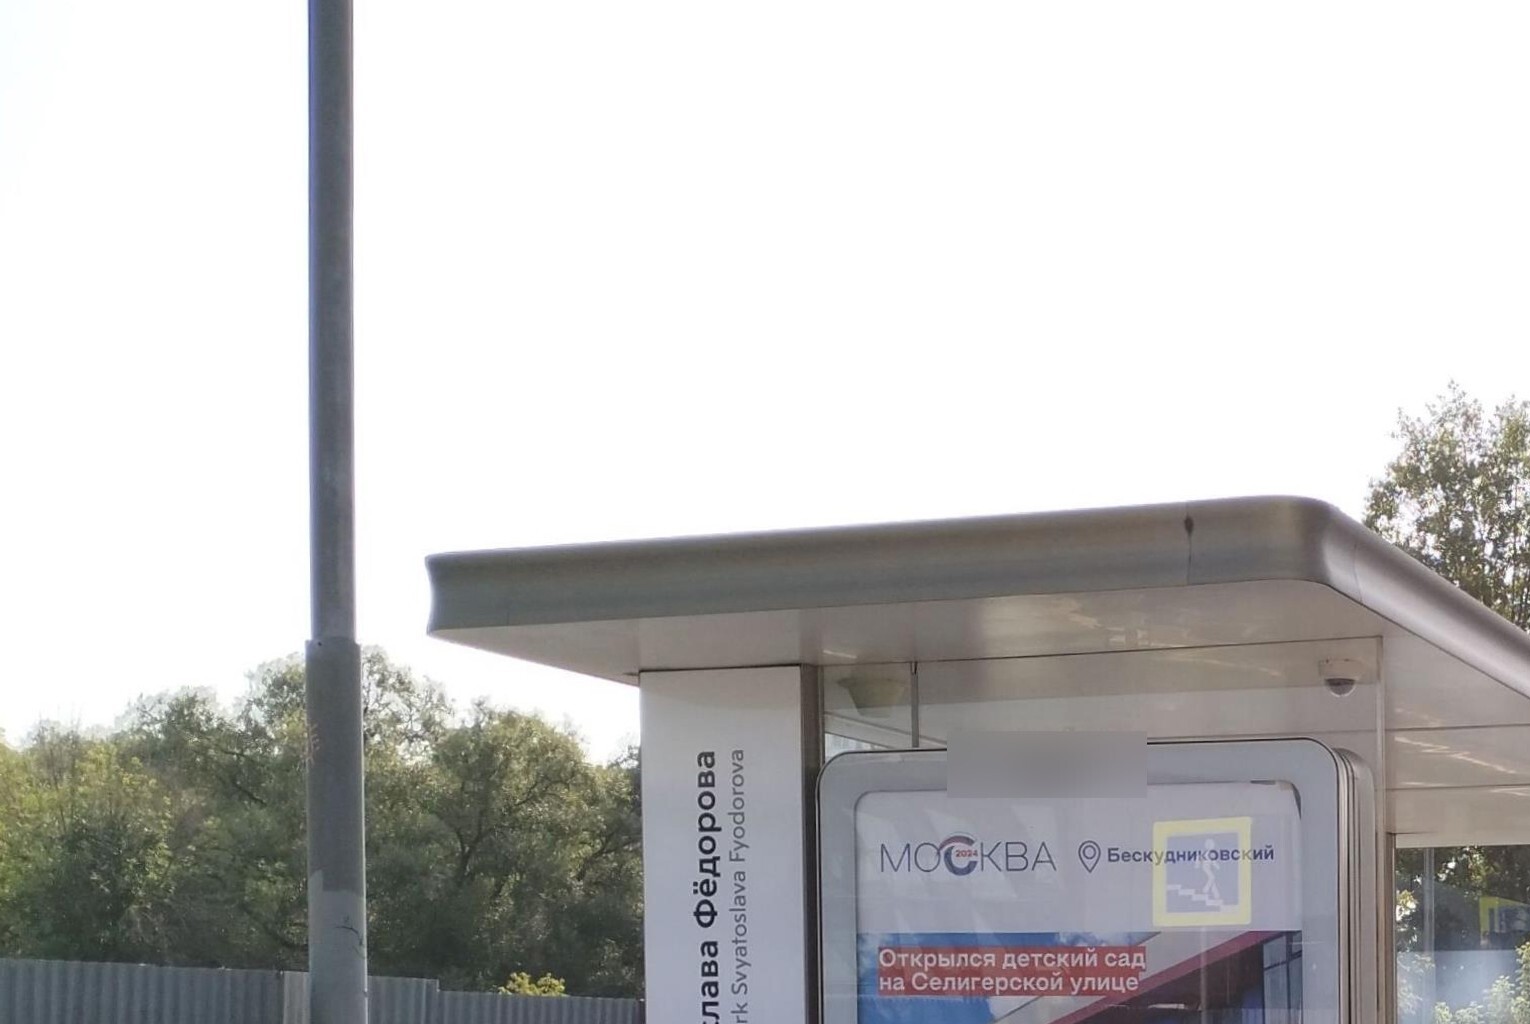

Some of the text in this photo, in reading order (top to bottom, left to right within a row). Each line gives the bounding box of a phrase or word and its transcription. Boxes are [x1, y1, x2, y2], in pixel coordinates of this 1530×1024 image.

[728, 750, 750, 861] Fyodorova
[693, 751, 722, 928] Фёдорова
[880, 832, 1057, 876] МОСКВА
[1107, 845, 1274, 866] Бескудниковский
[728, 871, 751, 995] Svyatoslava
[879, 948, 1146, 971] Открылся детский сад
[879, 972, 1139, 996] на Селигерской улице
